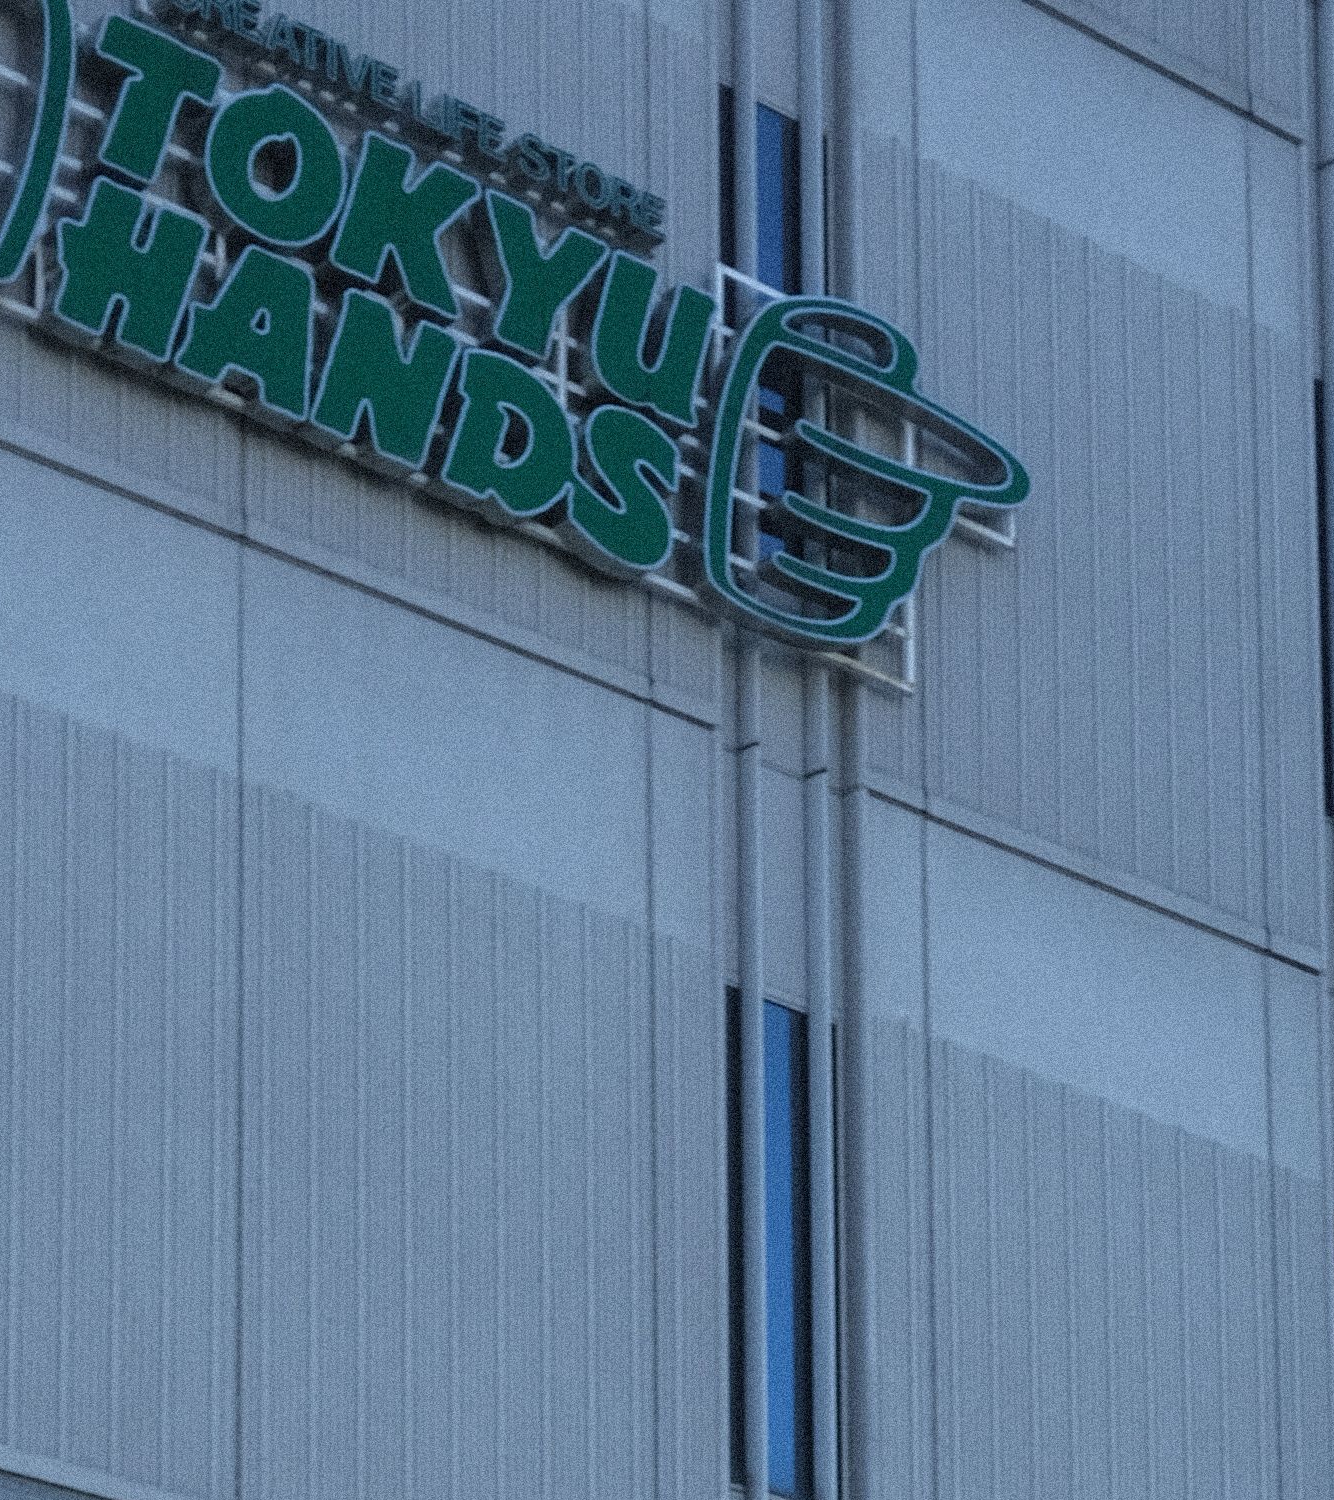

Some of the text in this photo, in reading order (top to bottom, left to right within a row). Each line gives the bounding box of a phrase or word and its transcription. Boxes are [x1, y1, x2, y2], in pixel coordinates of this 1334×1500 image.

[96, 14, 717, 428] TOKYU
[413, 79, 507, 162] LIFE
[518, 132, 666, 238] STORE
[53, 176, 681, 570] HANDS
